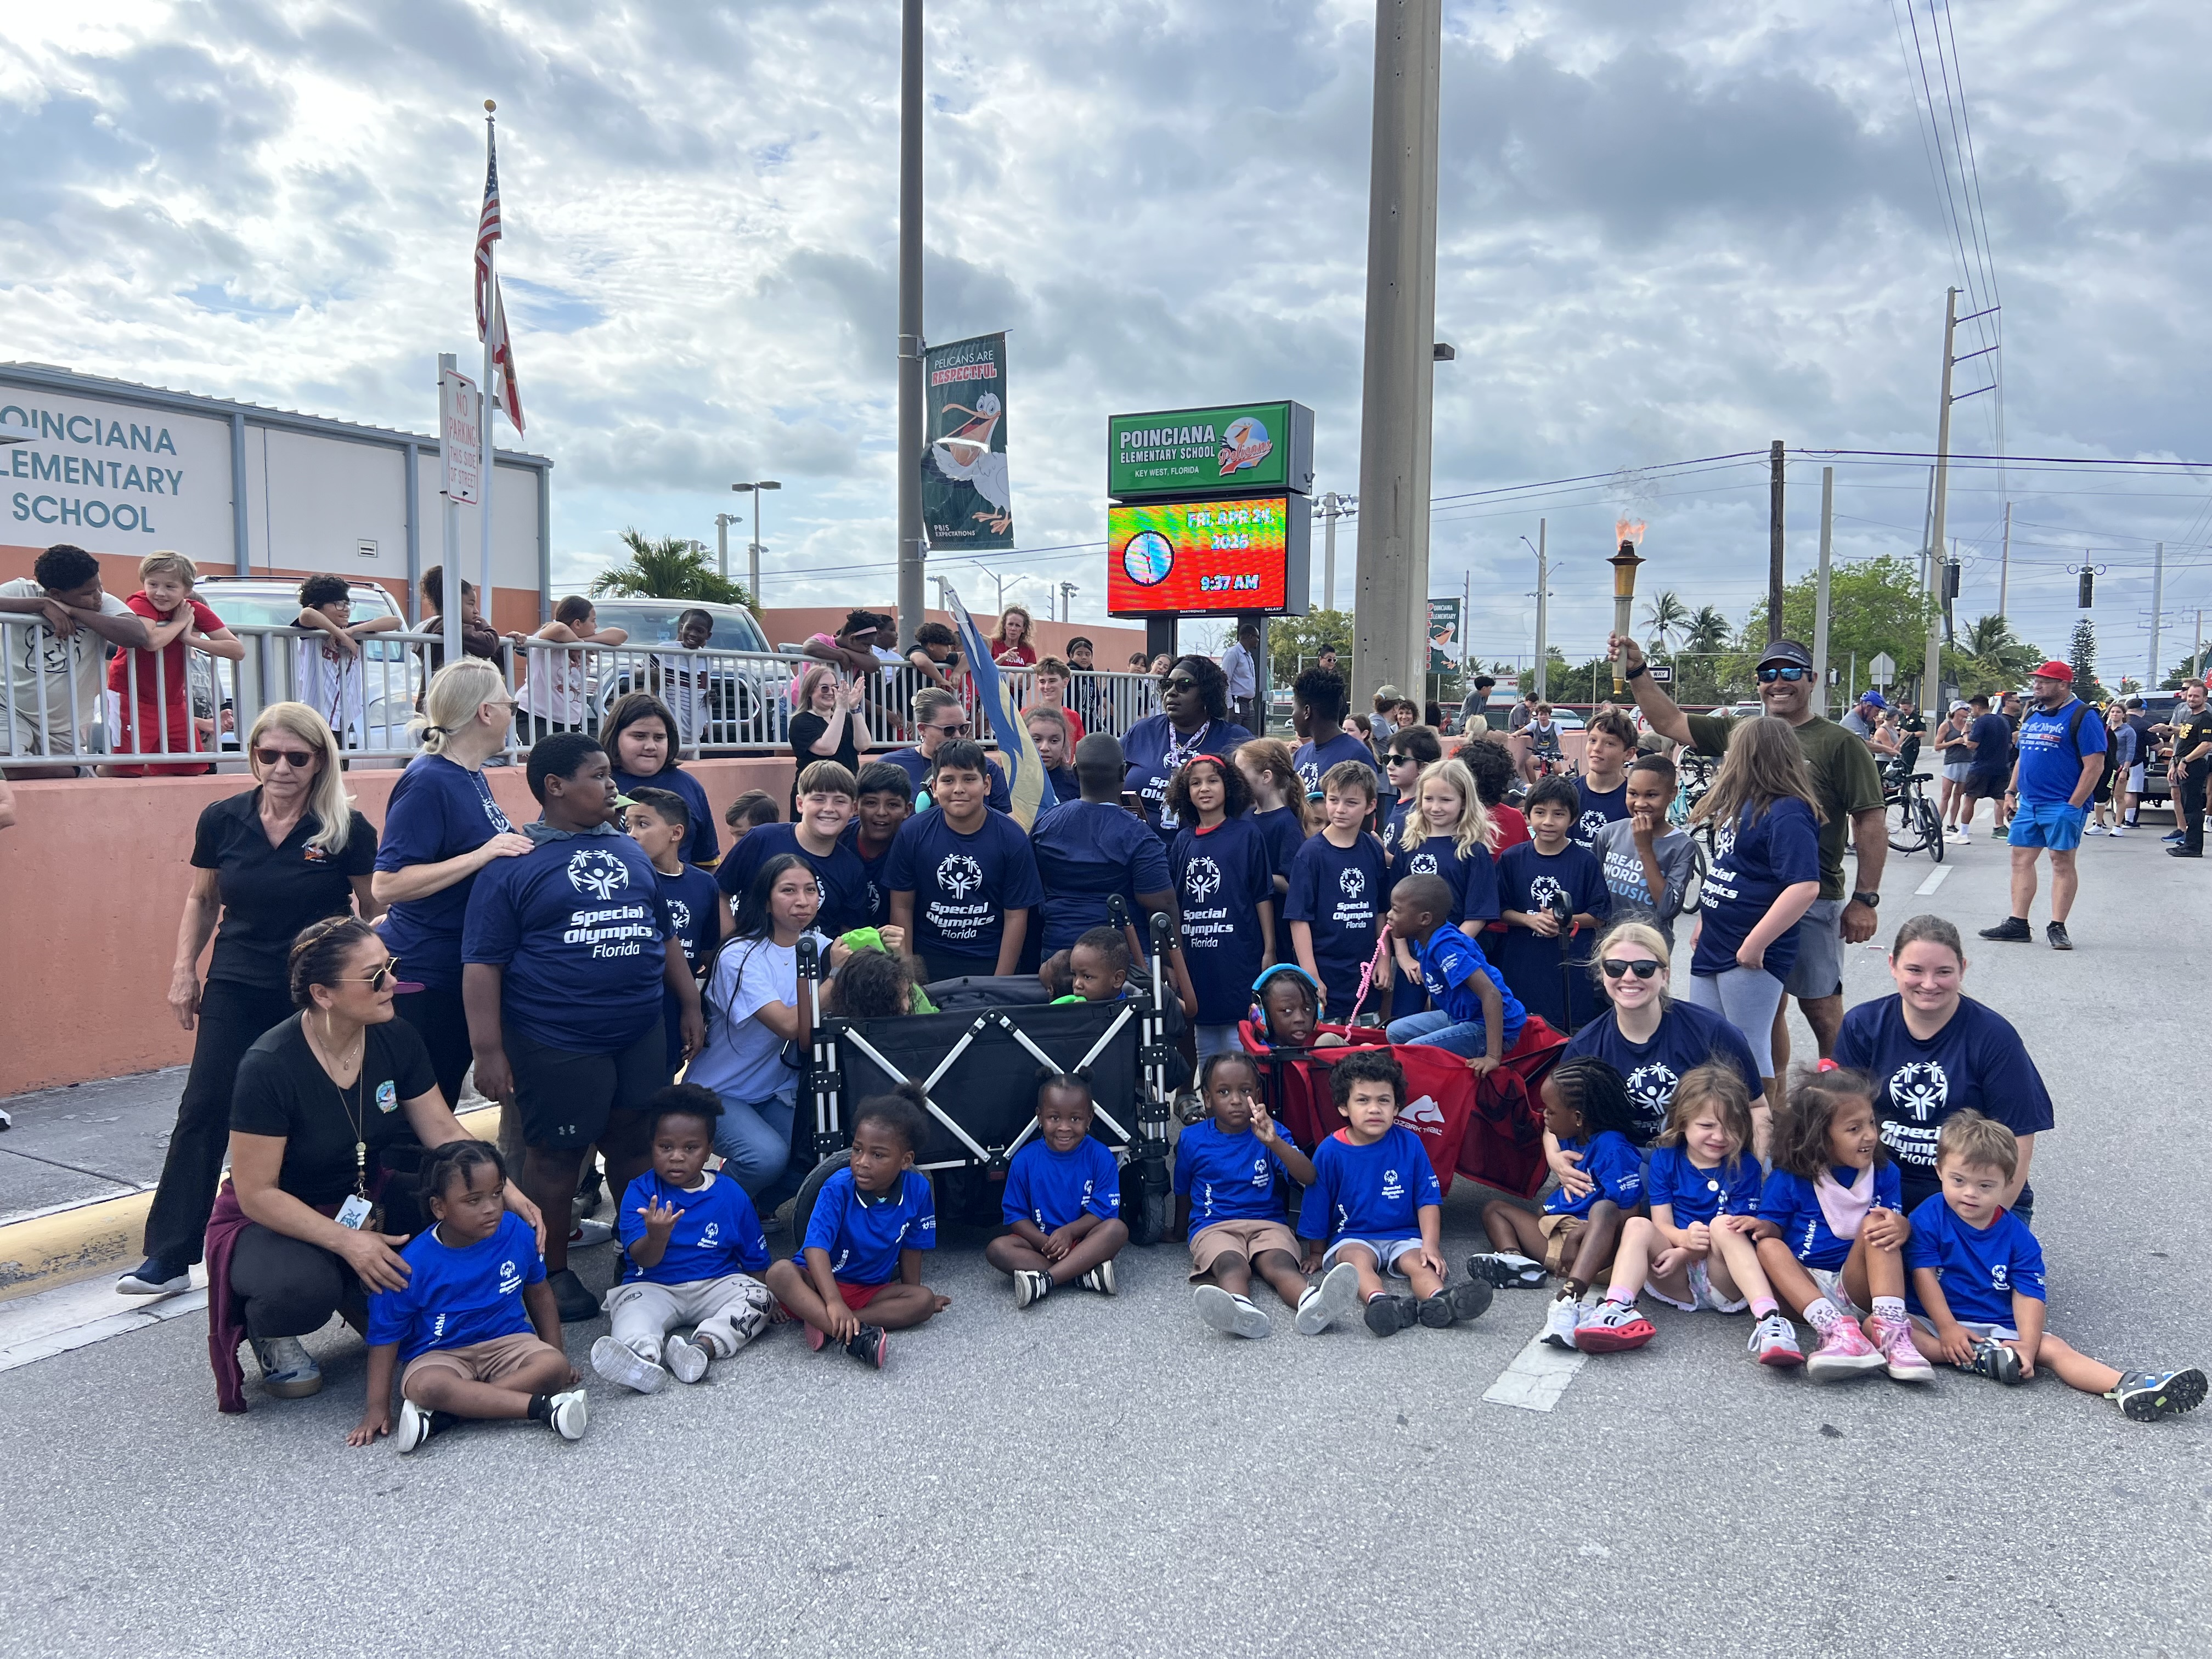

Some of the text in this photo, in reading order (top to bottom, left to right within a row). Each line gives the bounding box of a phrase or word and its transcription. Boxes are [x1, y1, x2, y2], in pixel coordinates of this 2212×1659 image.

[934, 349, 994, 370] PELICANS ARE
[932, 363, 997, 387] RESPECTFUL
[456, 391, 467, 417] NO
[0, 405, 177, 456] OINCIANA
[449, 416, 476, 448] PARKING
[1120, 425, 1216, 449] POINCIANA
[450, 446, 476, 469] THIS SIDE
[1120, 445, 1215, 464] ELEMENTARY SCHOOL
[1217, 439, 1274, 466] Pelicans
[0, 449, 183, 496] EMENTARY
[450, 467, 476, 489] OF STREET
[1149, 467, 1169, 477] WEST,
[1170, 466, 1199, 475] FLORIDA
[12, 492, 155, 533] SCHOOL
[1217, 509, 1249, 526] APR
[1200, 574, 1260, 591] 9:37 AM
[1605, 851, 1644, 872] PREAD
[1603, 862, 1640, 883] WORD
[570, 906, 644, 927] Special
[930, 901, 989, 915] Special
[1183, 907, 1227, 922] Special
[1333, 911, 1374, 921] Olympics
[1336, 901, 1369, 911] Special
[926, 911, 995, 928] Olympics
[1181, 922, 1234, 936] Olympics
[1346, 920, 1367, 929] Florida
[563, 923, 653, 944] Olympics
[941, 928, 977, 939] Florida
[1191, 936, 1218, 947] Florida
[592, 941, 640, 958] Florida
[1881, 1120, 1942, 1139] Speci
[1879, 1130, 1938, 1156] Olymp
